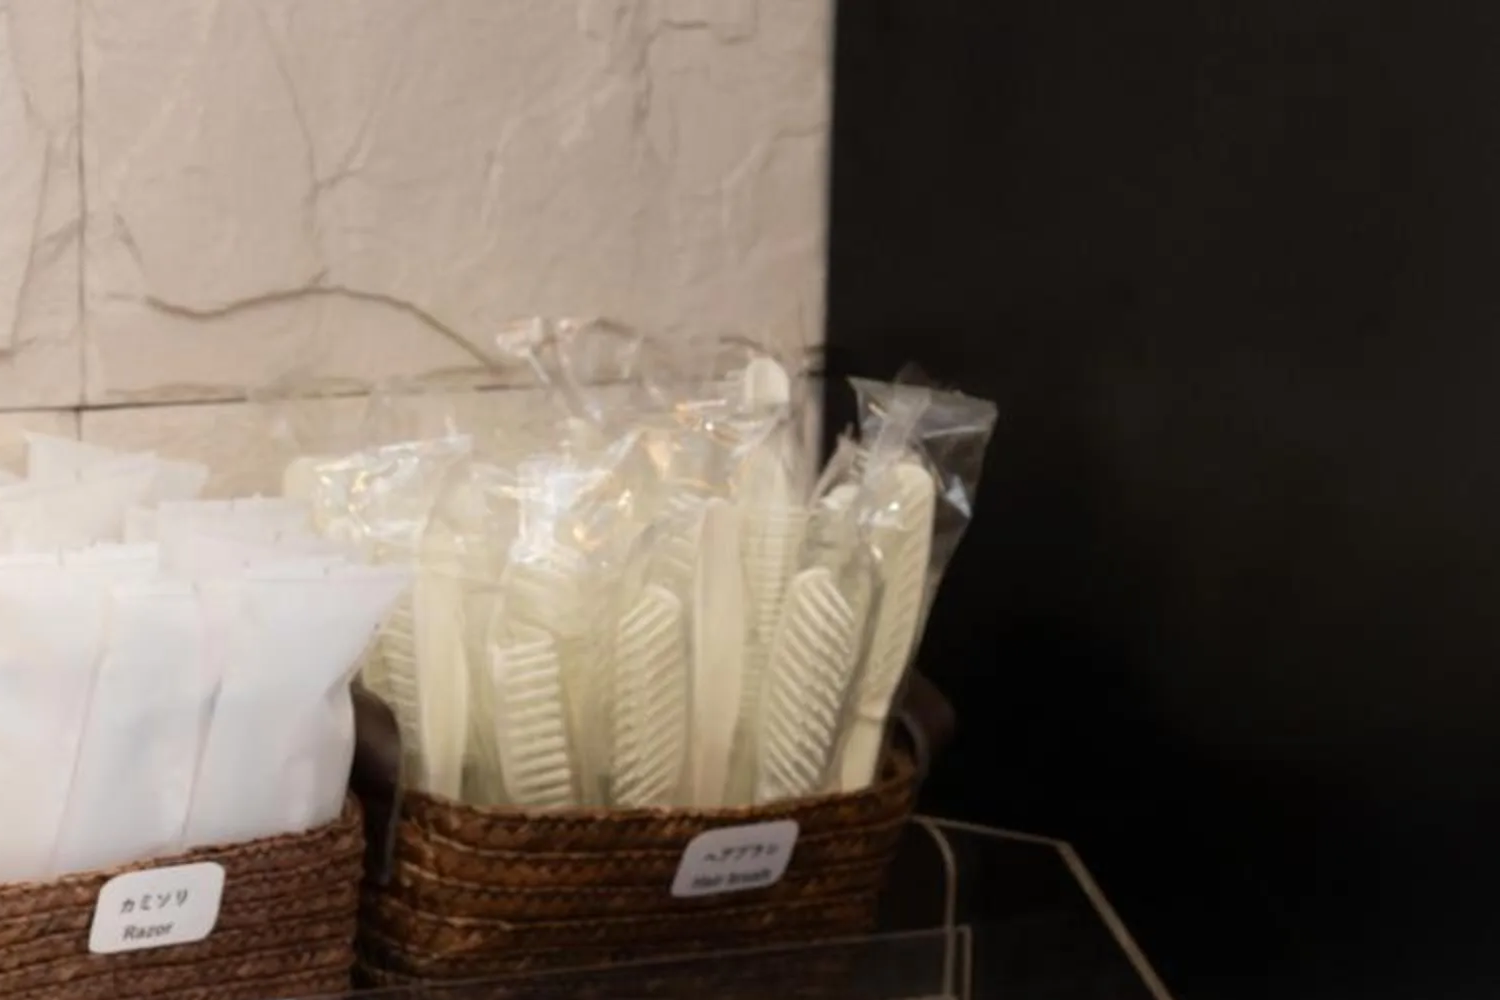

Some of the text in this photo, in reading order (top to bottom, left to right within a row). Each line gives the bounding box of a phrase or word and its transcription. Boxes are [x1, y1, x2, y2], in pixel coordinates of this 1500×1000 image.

[120, 889, 189, 913] カミソリ
[123, 922, 174, 940] Razor
